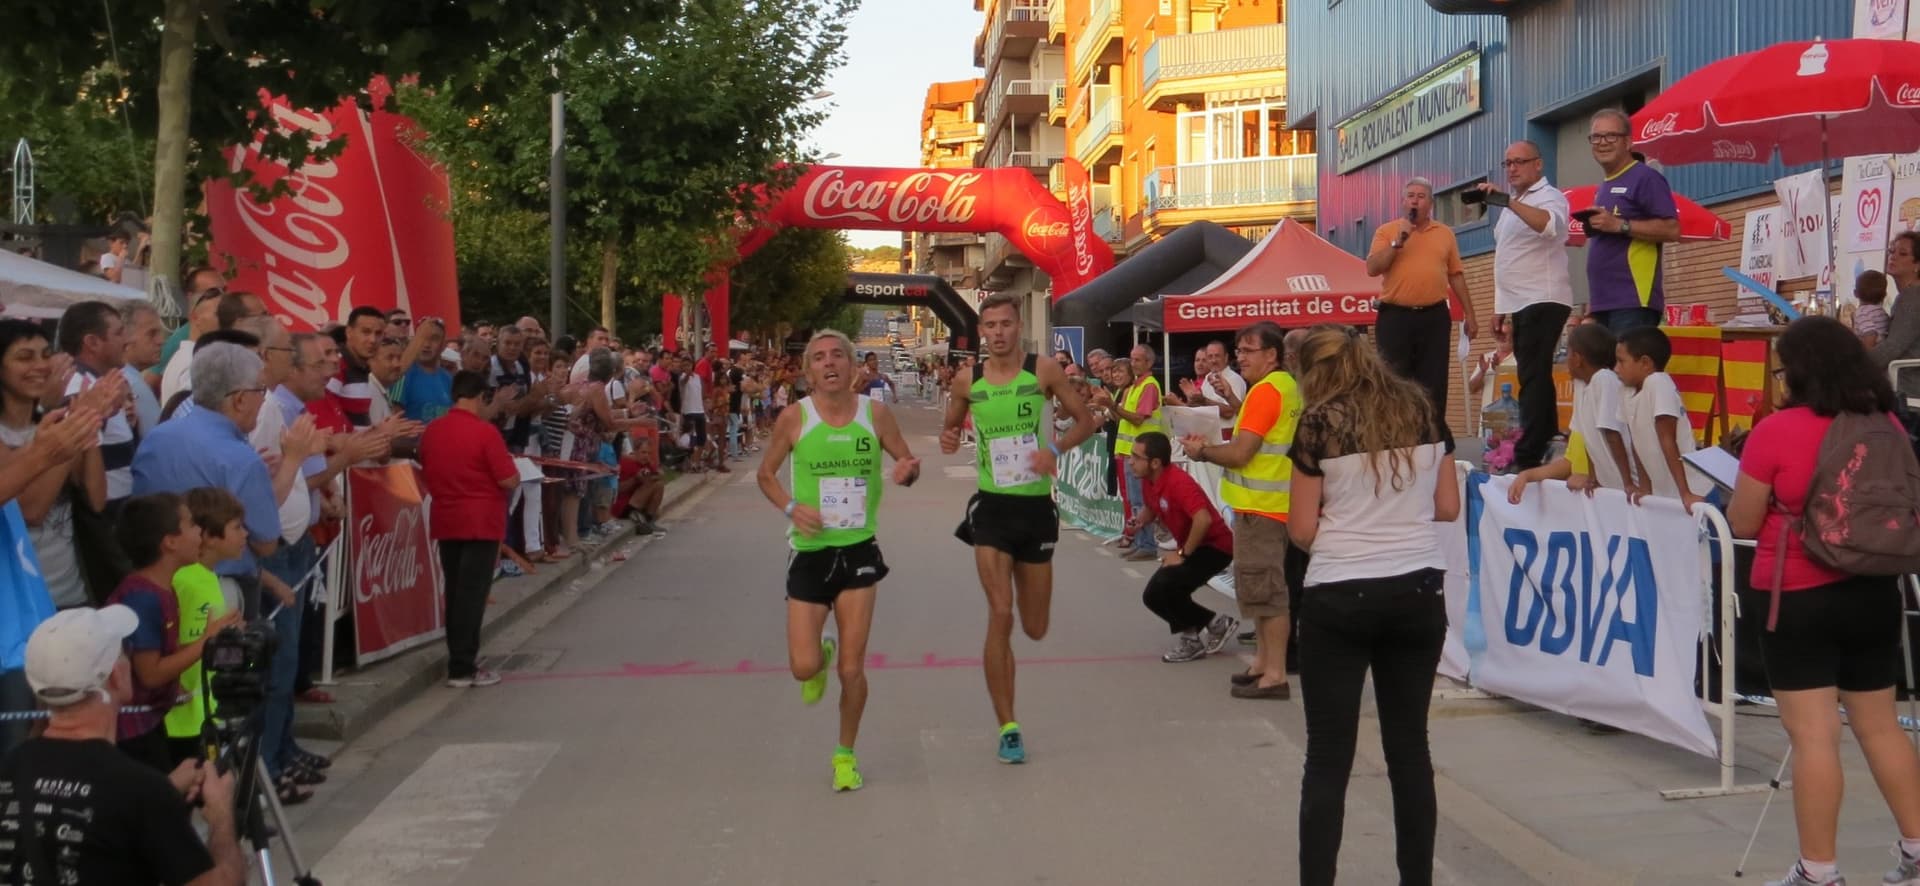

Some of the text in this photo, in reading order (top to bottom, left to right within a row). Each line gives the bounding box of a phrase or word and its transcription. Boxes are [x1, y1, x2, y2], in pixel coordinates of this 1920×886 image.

[1339, 66, 1475, 164] SALA POLIVALENT MUNICIPAL
[803, 169, 982, 223] Coca-Cola
[1028, 222, 1070, 238] Coca-Cola
[1070, 182, 1093, 275] Coca-Cola
[855, 283, 928, 299] esportcat
[1178, 299, 1301, 320] Generalitat
[1305, 297, 1334, 315] de
[1017, 402, 1032, 417] LS
[856, 437, 871, 453] LS
[810, 458, 872, 471] LASANSI.COM
[1503, 527, 1658, 678] BBVA
